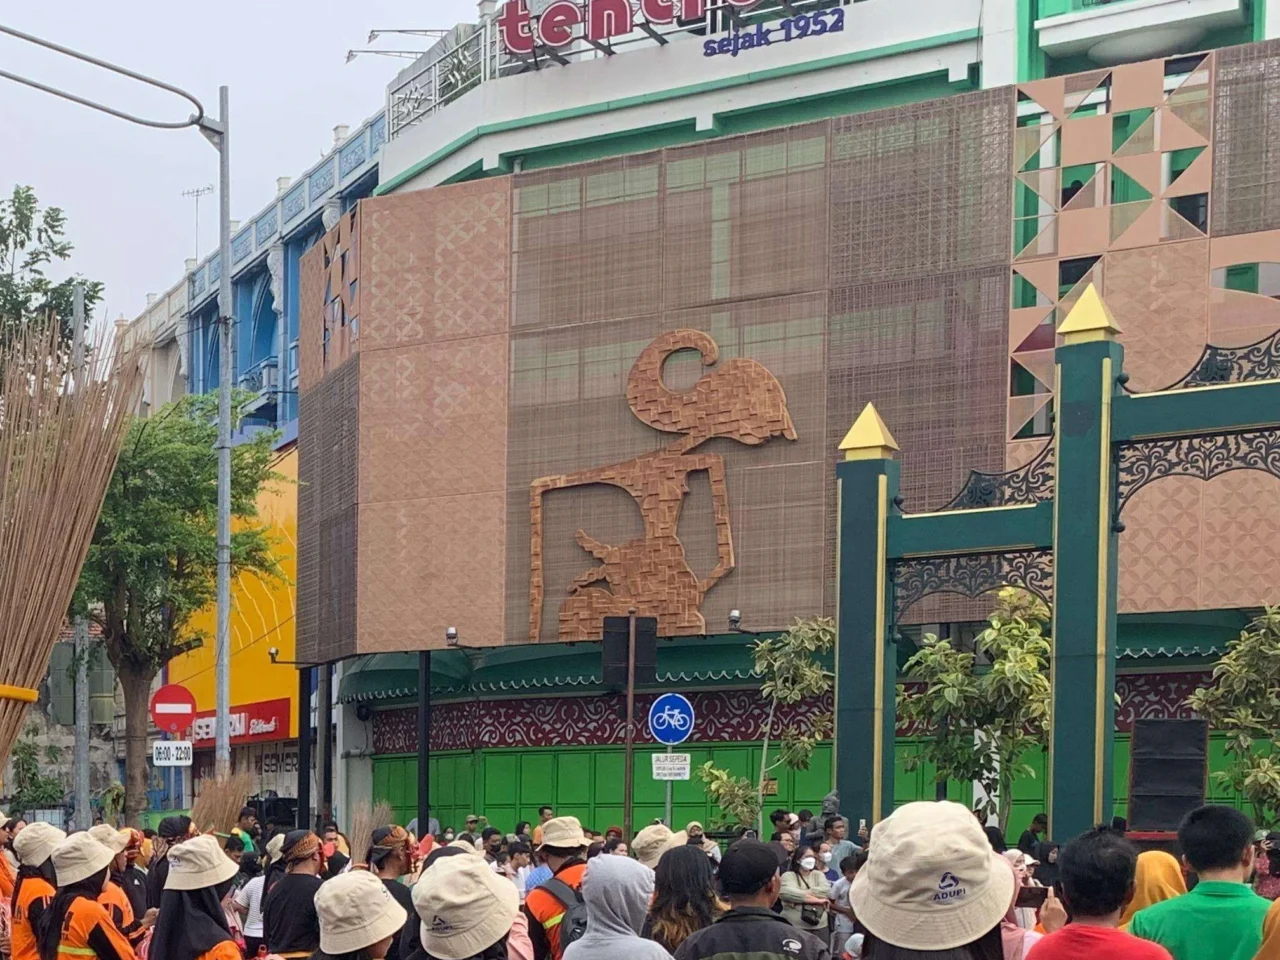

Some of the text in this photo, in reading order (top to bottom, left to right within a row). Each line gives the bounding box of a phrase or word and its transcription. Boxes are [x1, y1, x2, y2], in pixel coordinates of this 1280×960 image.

[703, 8, 845, 57] sejak 1952
[195, 713, 246, 740] SERU
[263, 752, 299, 773] SEMER
[933, 889, 966, 902] ADUPI
